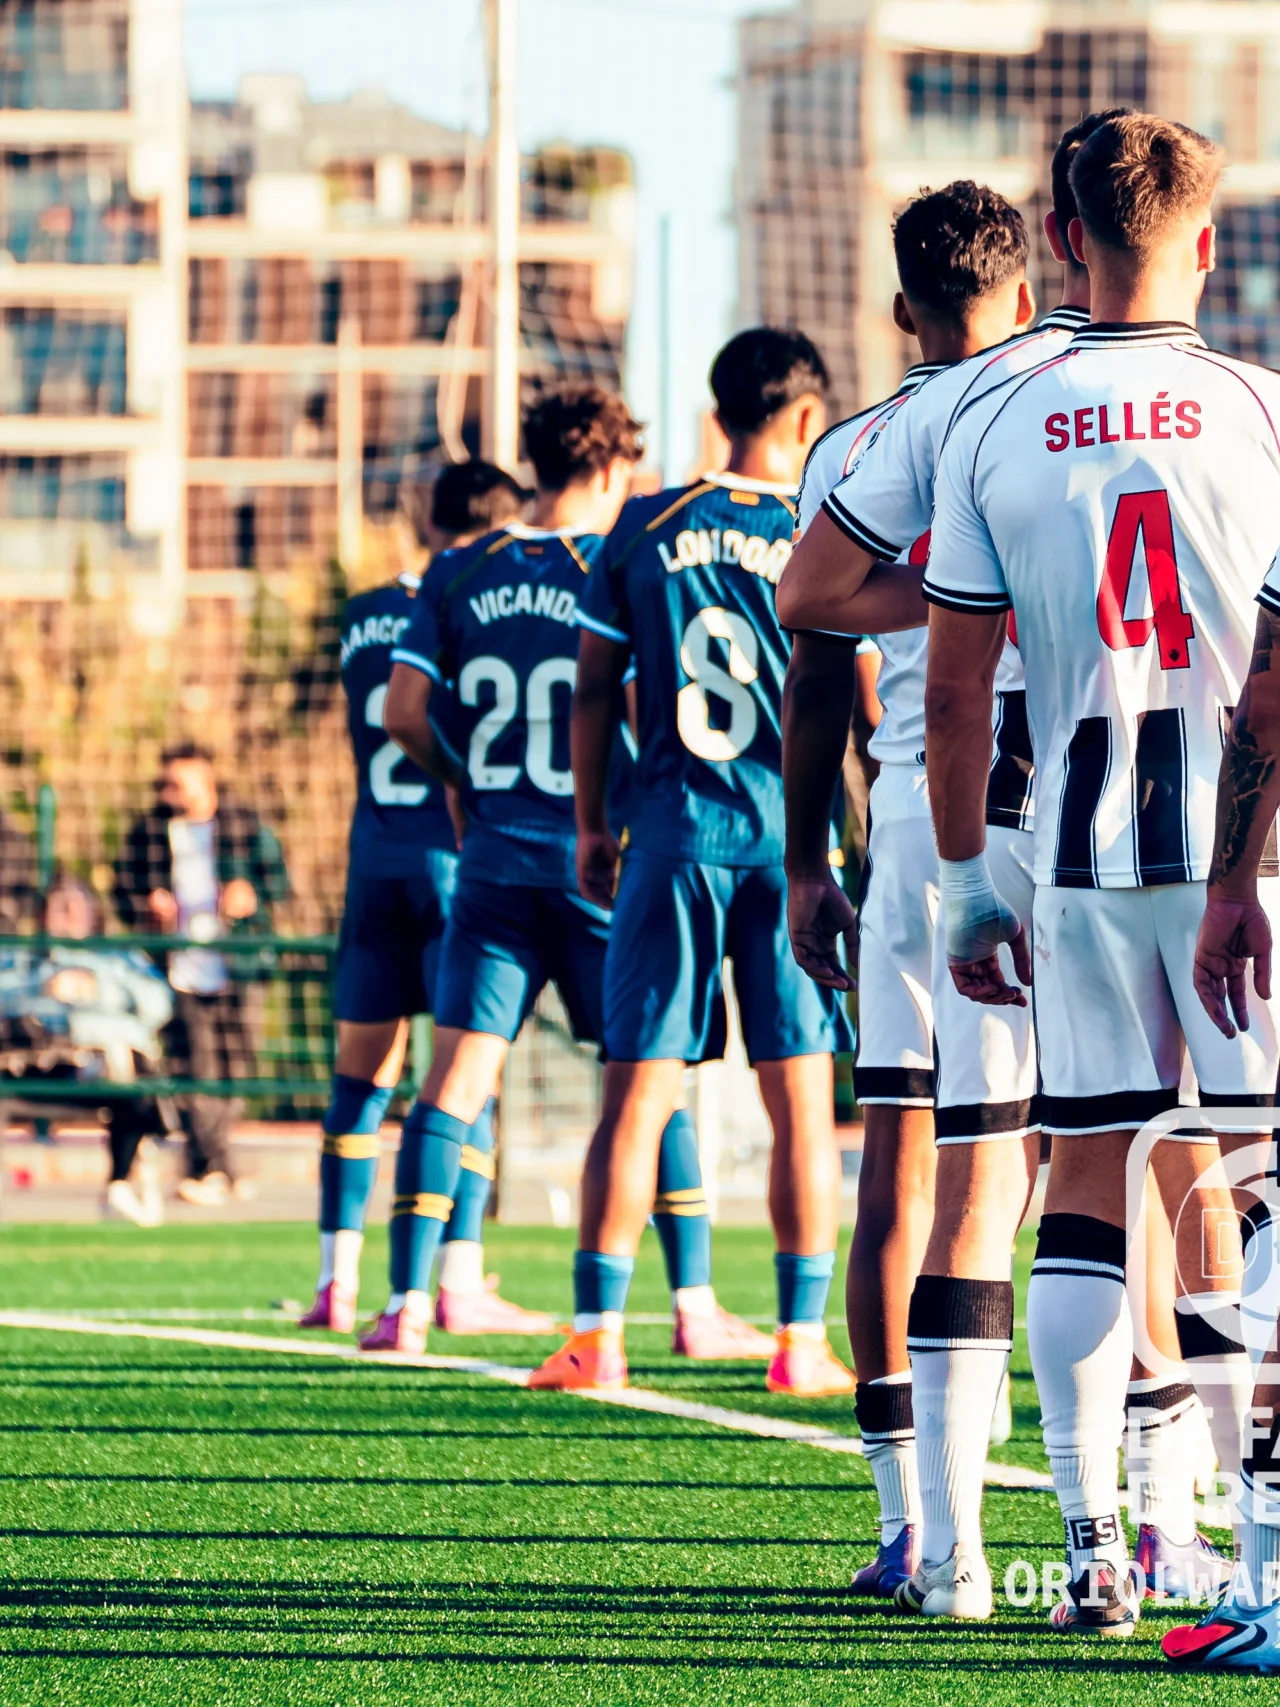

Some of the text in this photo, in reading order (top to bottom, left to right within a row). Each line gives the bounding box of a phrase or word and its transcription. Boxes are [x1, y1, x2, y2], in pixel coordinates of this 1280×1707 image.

[1045, 391, 1202, 452] SELLÉS
[469, 582, 577, 628] VICAND
[1096, 489, 1195, 670] 4
[459, 655, 578, 795] 20
[677, 606, 758, 761] 8
[1074, 1516, 1116, 1547] FS
